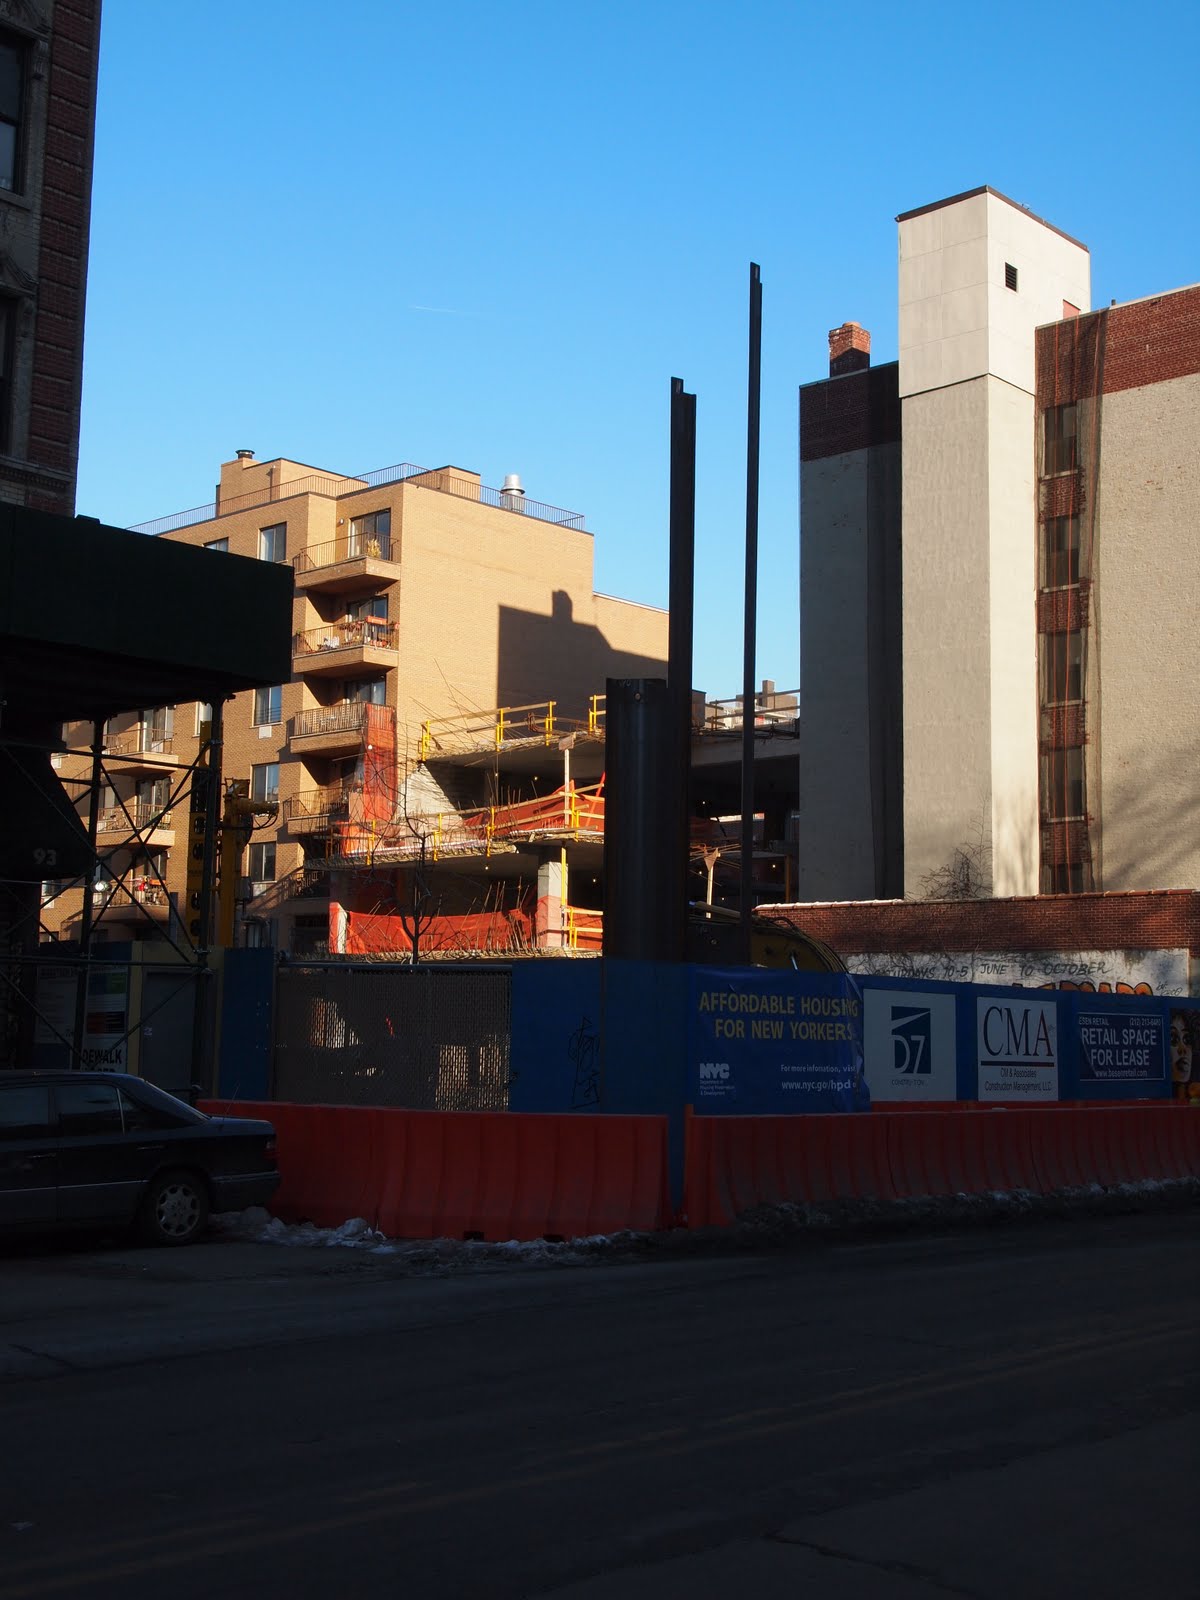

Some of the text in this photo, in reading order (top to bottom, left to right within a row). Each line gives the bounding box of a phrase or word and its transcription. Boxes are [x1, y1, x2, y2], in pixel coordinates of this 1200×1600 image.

[33, 848, 57, 865] 93
[981, 963, 1006, 975] JUNE
[1043, 961, 1112, 975] OCTOBER
[699, 991, 859, 1017] AFFORDABLE HOUSING
[1078, 1016, 1110, 1026] ESEN RETAIL
[1129, 1017, 1142, 1026] (212)
[715, 1018, 853, 1041] FOR NEW YORKERS
[983, 1006, 1054, 1057] CMA
[1081, 1027, 1157, 1046] RETAIL SPACE
[82, 1048, 122, 1064] DEWALK
[1091, 1048, 1150, 1066] FOR LEASE
[699, 1063, 730, 1079] NYC
[780, 1064, 790, 1072] For
[1014, 1068, 1037, 1078] Associates
[984, 1081, 1012, 1091] Construction
